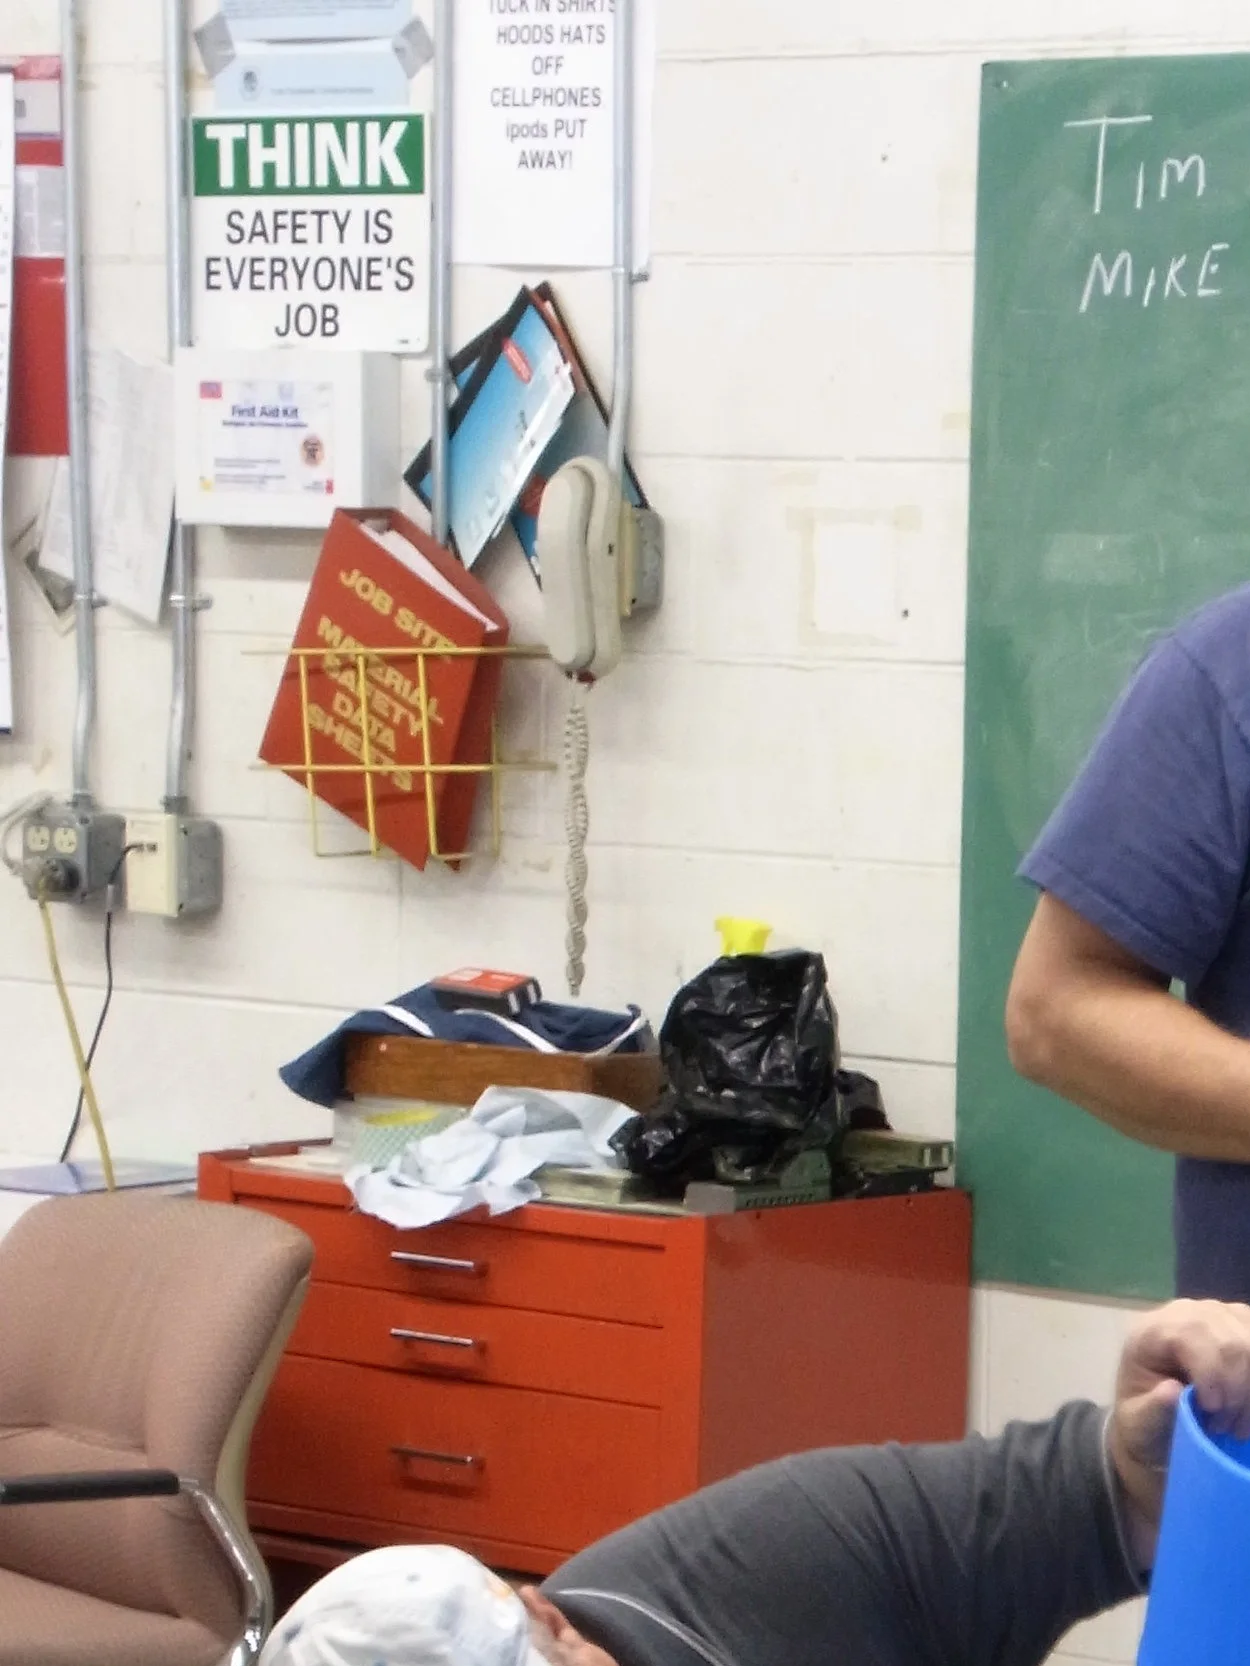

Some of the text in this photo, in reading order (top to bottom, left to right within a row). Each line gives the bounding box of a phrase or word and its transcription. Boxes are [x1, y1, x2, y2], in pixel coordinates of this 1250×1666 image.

[496, 24, 606, 45] HOODS HATS
[531, 55, 564, 76] OFF
[490, 87, 601, 108] CELLPHONES
[506, 118, 587, 143] ipods PUT
[205, 120, 411, 188] THINK
[517, 149, 573, 170] AWAY!
[225, 208, 394, 244] SAFETY IS
[205, 255, 415, 291] EVERYONE'S
[1078, 243, 1232, 314] MIKE
[274, 302, 340, 337] JOB
[231, 404, 299, 418] First Aid Kit
[339, 568, 457, 663] JOB SITE
